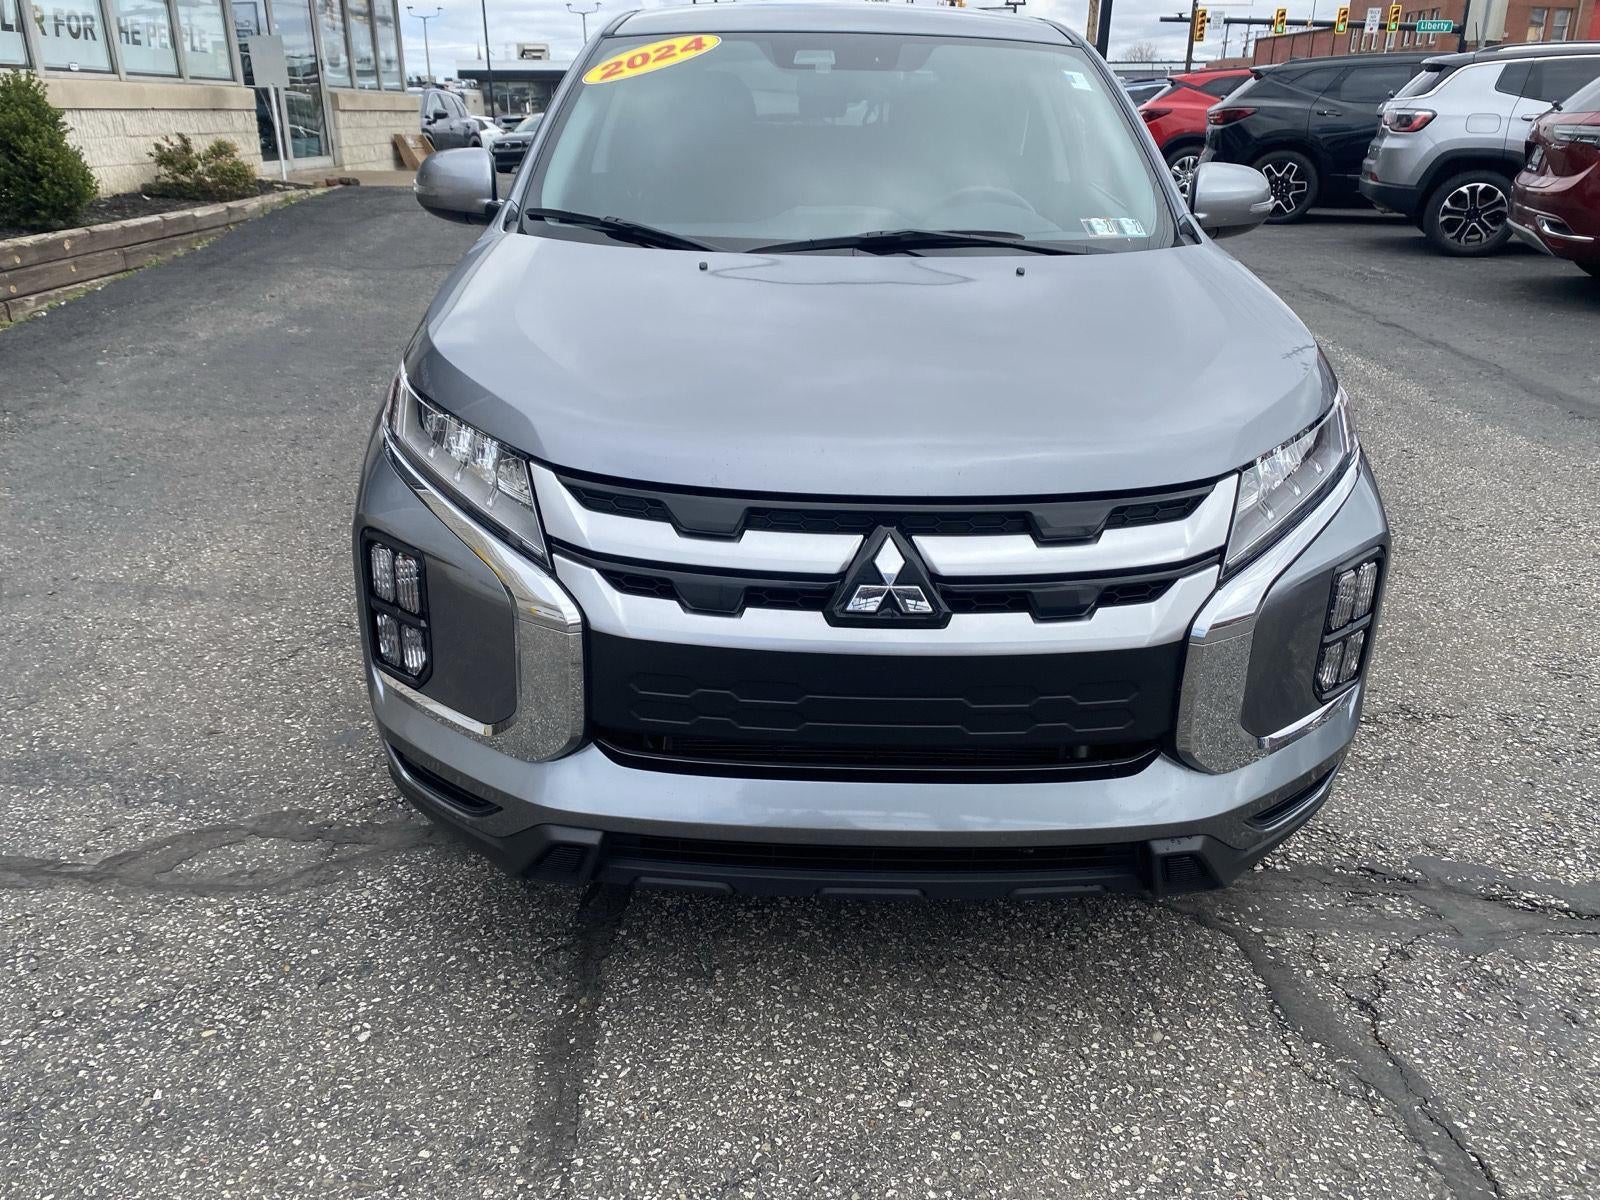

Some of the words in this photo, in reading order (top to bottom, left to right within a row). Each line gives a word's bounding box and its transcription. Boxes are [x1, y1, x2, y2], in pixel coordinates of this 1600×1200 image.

[53, 8, 97, 41] FOR
[116, 16, 142, 46] HE
[145, 21, 209, 53] PEPLE
[1420, 22, 1449, 31] Liberty
[600, 36, 706, 80] 2024
